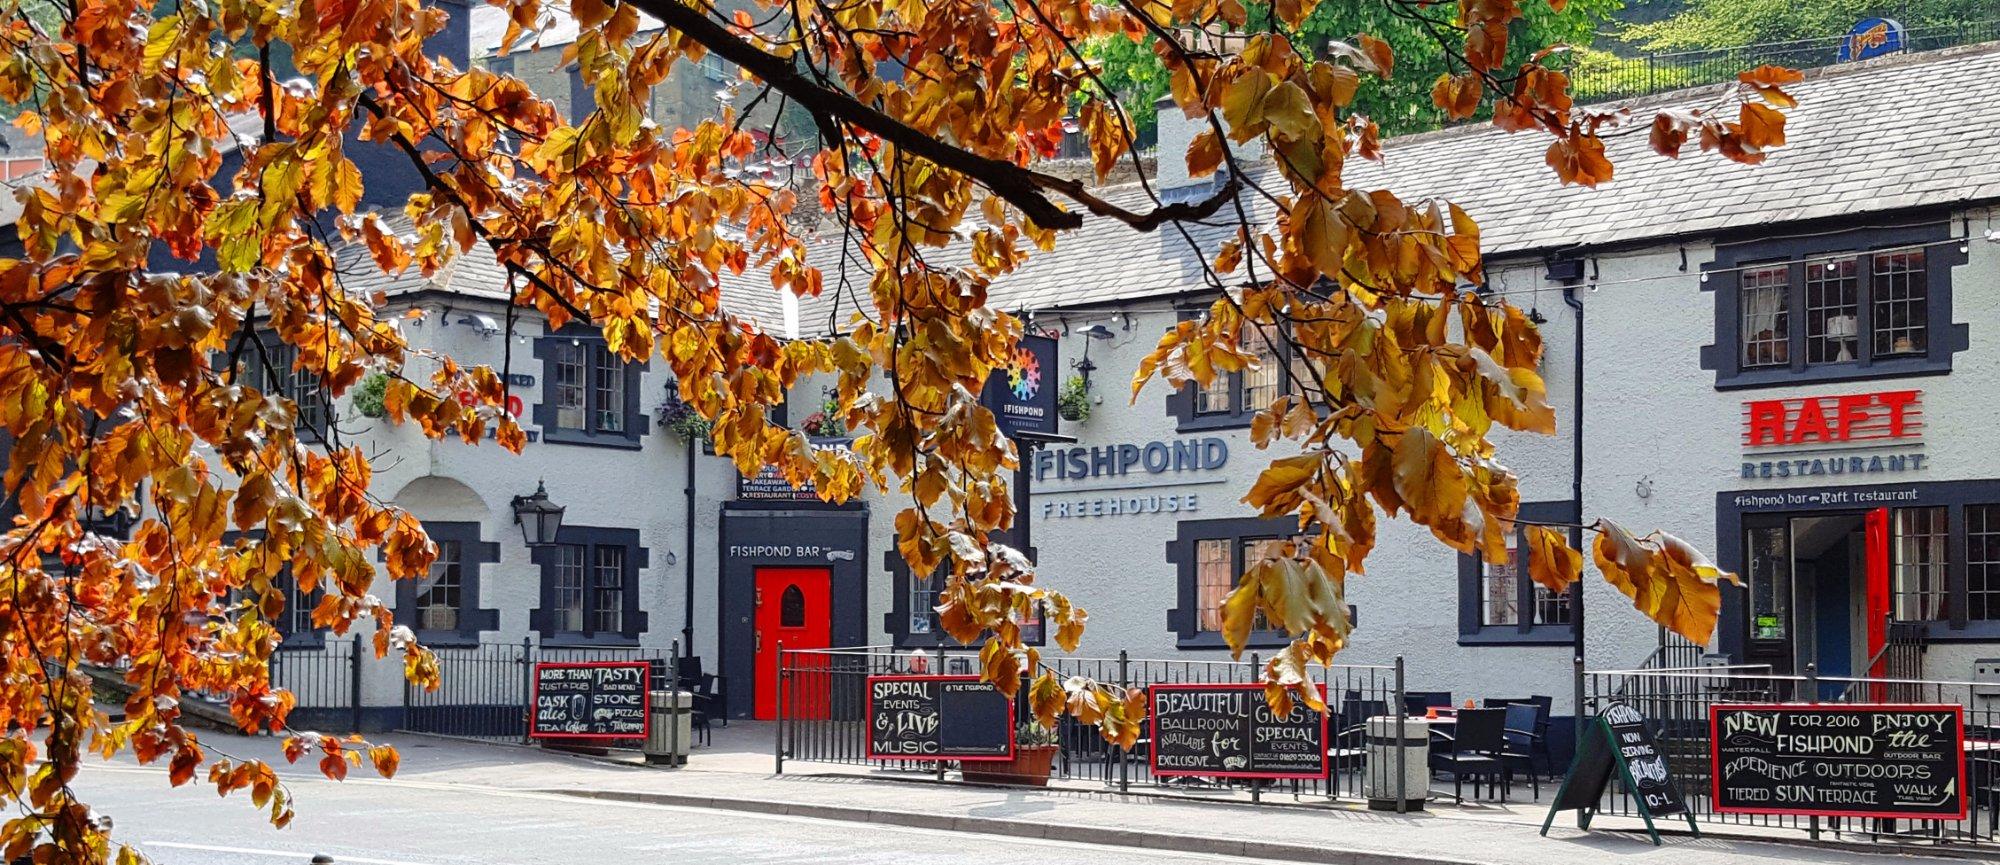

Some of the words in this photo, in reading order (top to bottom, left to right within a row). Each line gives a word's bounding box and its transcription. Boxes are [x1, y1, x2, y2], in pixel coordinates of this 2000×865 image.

[1008, 404, 1044, 417] FISHPOND
[1749, 391, 1918, 446] RAFT
[1036, 437, 1228, 482] FISHPOND
[1741, 454, 1926, 479] RESTAURANT
[1788, 494, 1807, 504] bar
[1853, 488, 1918, 502] restaurant
[1043, 493, 1199, 520] FREEHOUSE
[730, 546, 792, 557] FISHPOND
[796, 546, 820, 557] BAR
[540, 669, 566, 680] MORE
[566, 668, 592, 680] THAN
[594, 668, 644, 686] TASTY
[539, 682, 563, 690] JUST
[570, 682, 590, 690] PUB
[874, 682, 933, 700] SPECIAL
[538, 695, 570, 708] CASK
[594, 694, 641, 704] STONE
[884, 700, 920, 710] EVENTS
[1156, 692, 1248, 718] BEAUTIFUL
[614, 708, 644, 718] PIZZAS
[538, 723, 560, 732] TEA
[876, 712, 888, 730] &
[897, 712, 939, 736] LIVE
[1161, 718, 1240, 731] BALLROOM
[1724, 711, 1780, 740] NEW
[1789, 714, 1822, 727] FOR
[1826, 715, 1860, 727] 2016
[1872, 713, 1951, 734] ENJOY
[1162, 732, 1206, 750] AVAILABLE
[1211, 730, 1240, 758] for
[1256, 726, 1318, 746] SPECIAL
[1622, 732, 1642, 743] NOW
[1777, 734, 1874, 754] FISHPOND
[1888, 730, 1932, 748] the
[874, 740, 938, 754] MUSIC
[1621, 744, 1654, 758] SERVING
[1158, 755, 1210, 767] EXCLUSIVE
[1884, 752, 1920, 760] OUTDOOR
[1922, 752, 1942, 760] BAR
[1725, 756, 1808, 781] EXPERIENCE
[1815, 762, 1932, 780] OUTDOORS
[1727, 787, 1770, 801] TIERED
[1776, 784, 1816, 802] SUN
[1816, 788, 1878, 804] TERRACE
[1894, 784, 1938, 796] WALK
